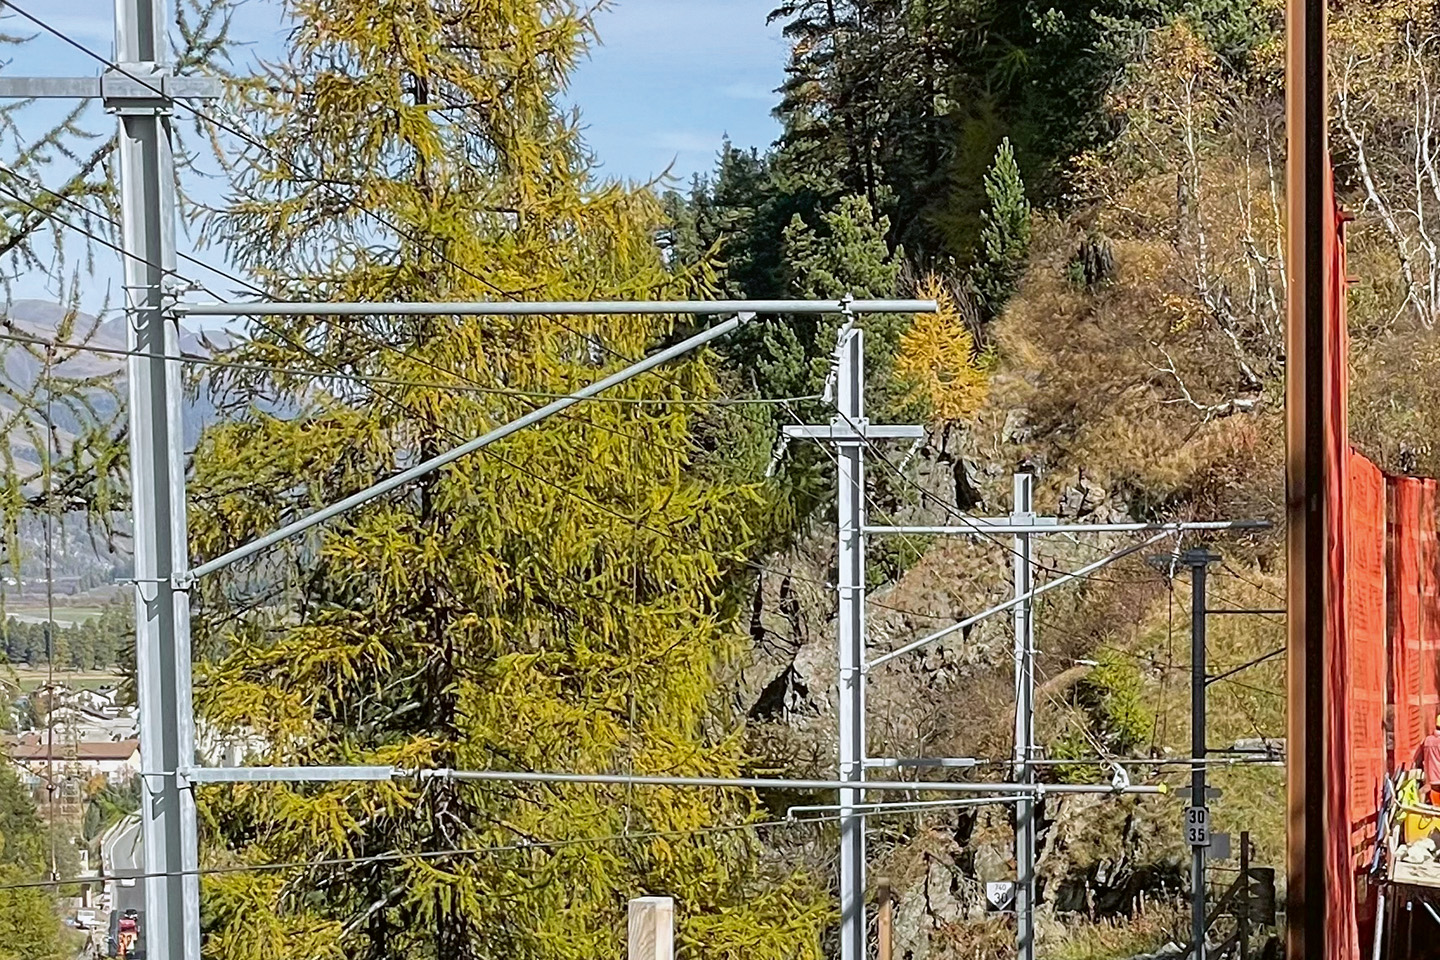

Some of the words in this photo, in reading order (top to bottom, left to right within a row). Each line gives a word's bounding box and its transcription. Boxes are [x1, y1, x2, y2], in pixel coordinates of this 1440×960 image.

[1189, 810, 1205, 824] 30
[1189, 828, 1205, 842] 35
[994, 892, 1008, 904] 30
